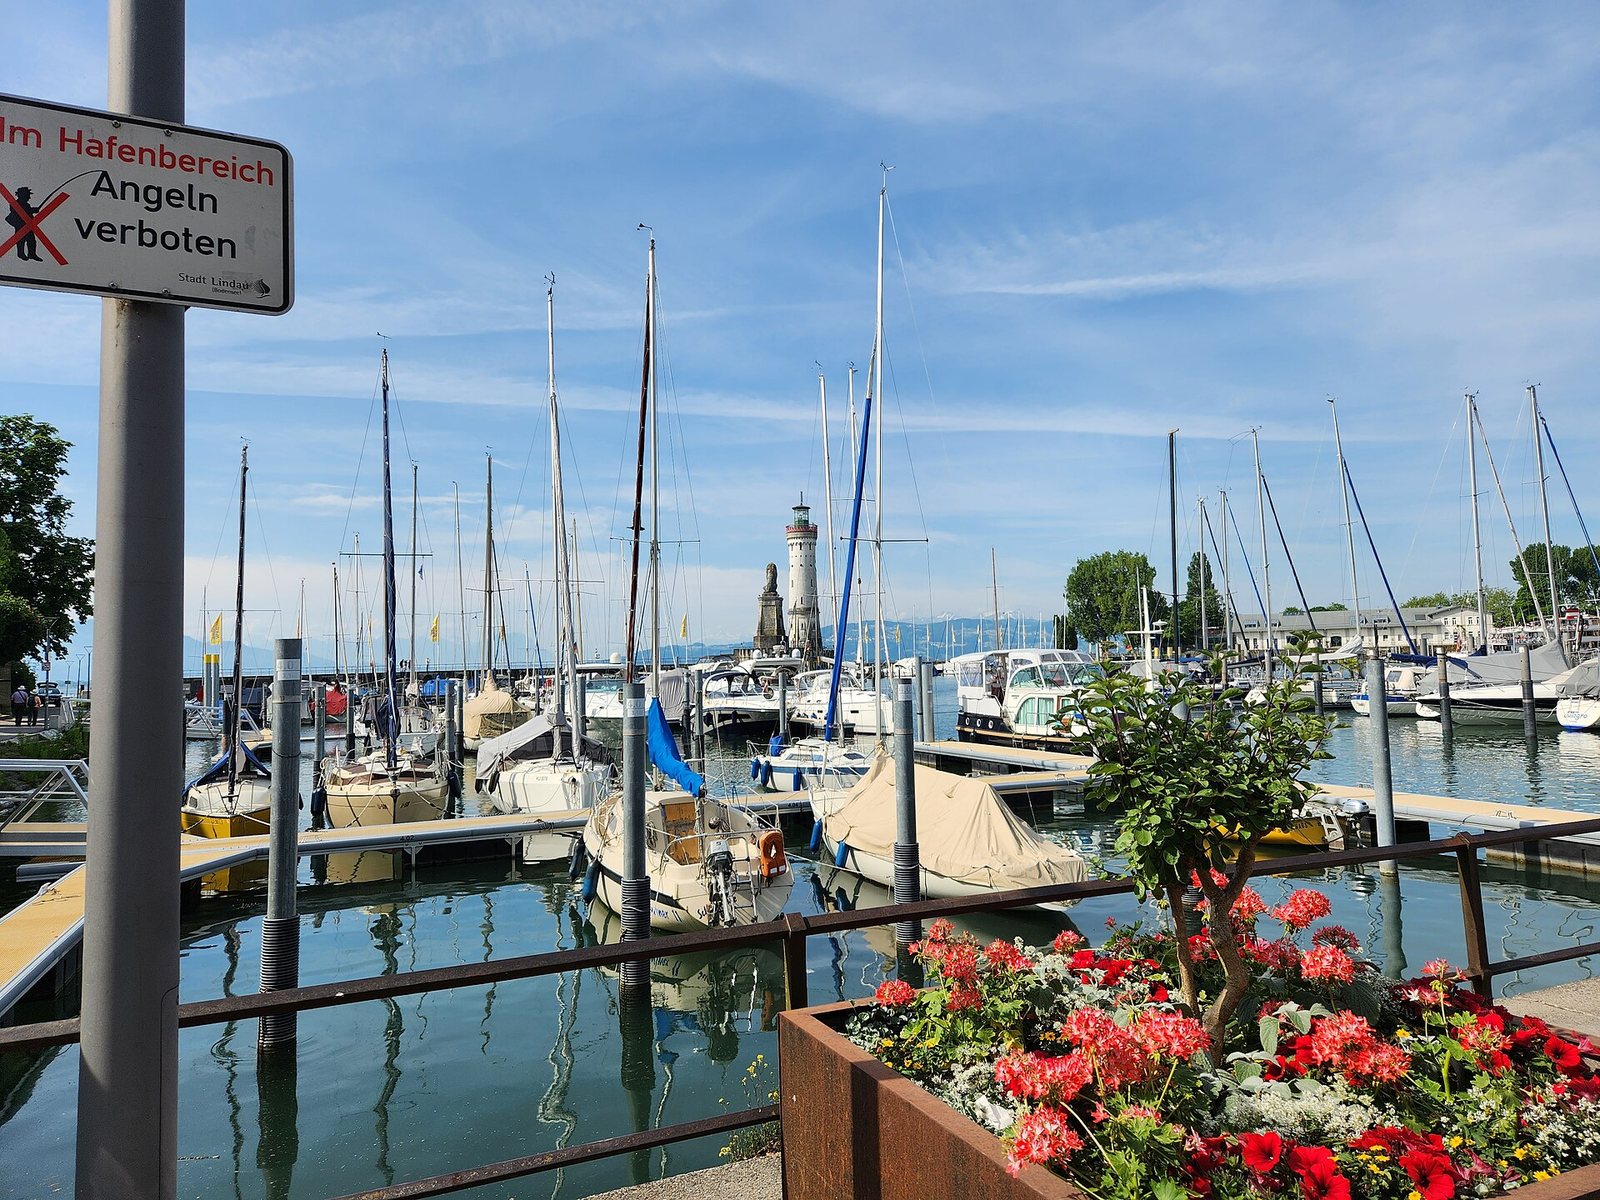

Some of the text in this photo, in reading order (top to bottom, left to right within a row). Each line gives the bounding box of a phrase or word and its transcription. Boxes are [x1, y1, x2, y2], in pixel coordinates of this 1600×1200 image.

[0, 116, 274, 186] Im Hafenbereich
[90, 170, 218, 214] Angeln
[74, 217, 236, 259] verboten
[178, 272, 249, 290] Stadt Lindau
